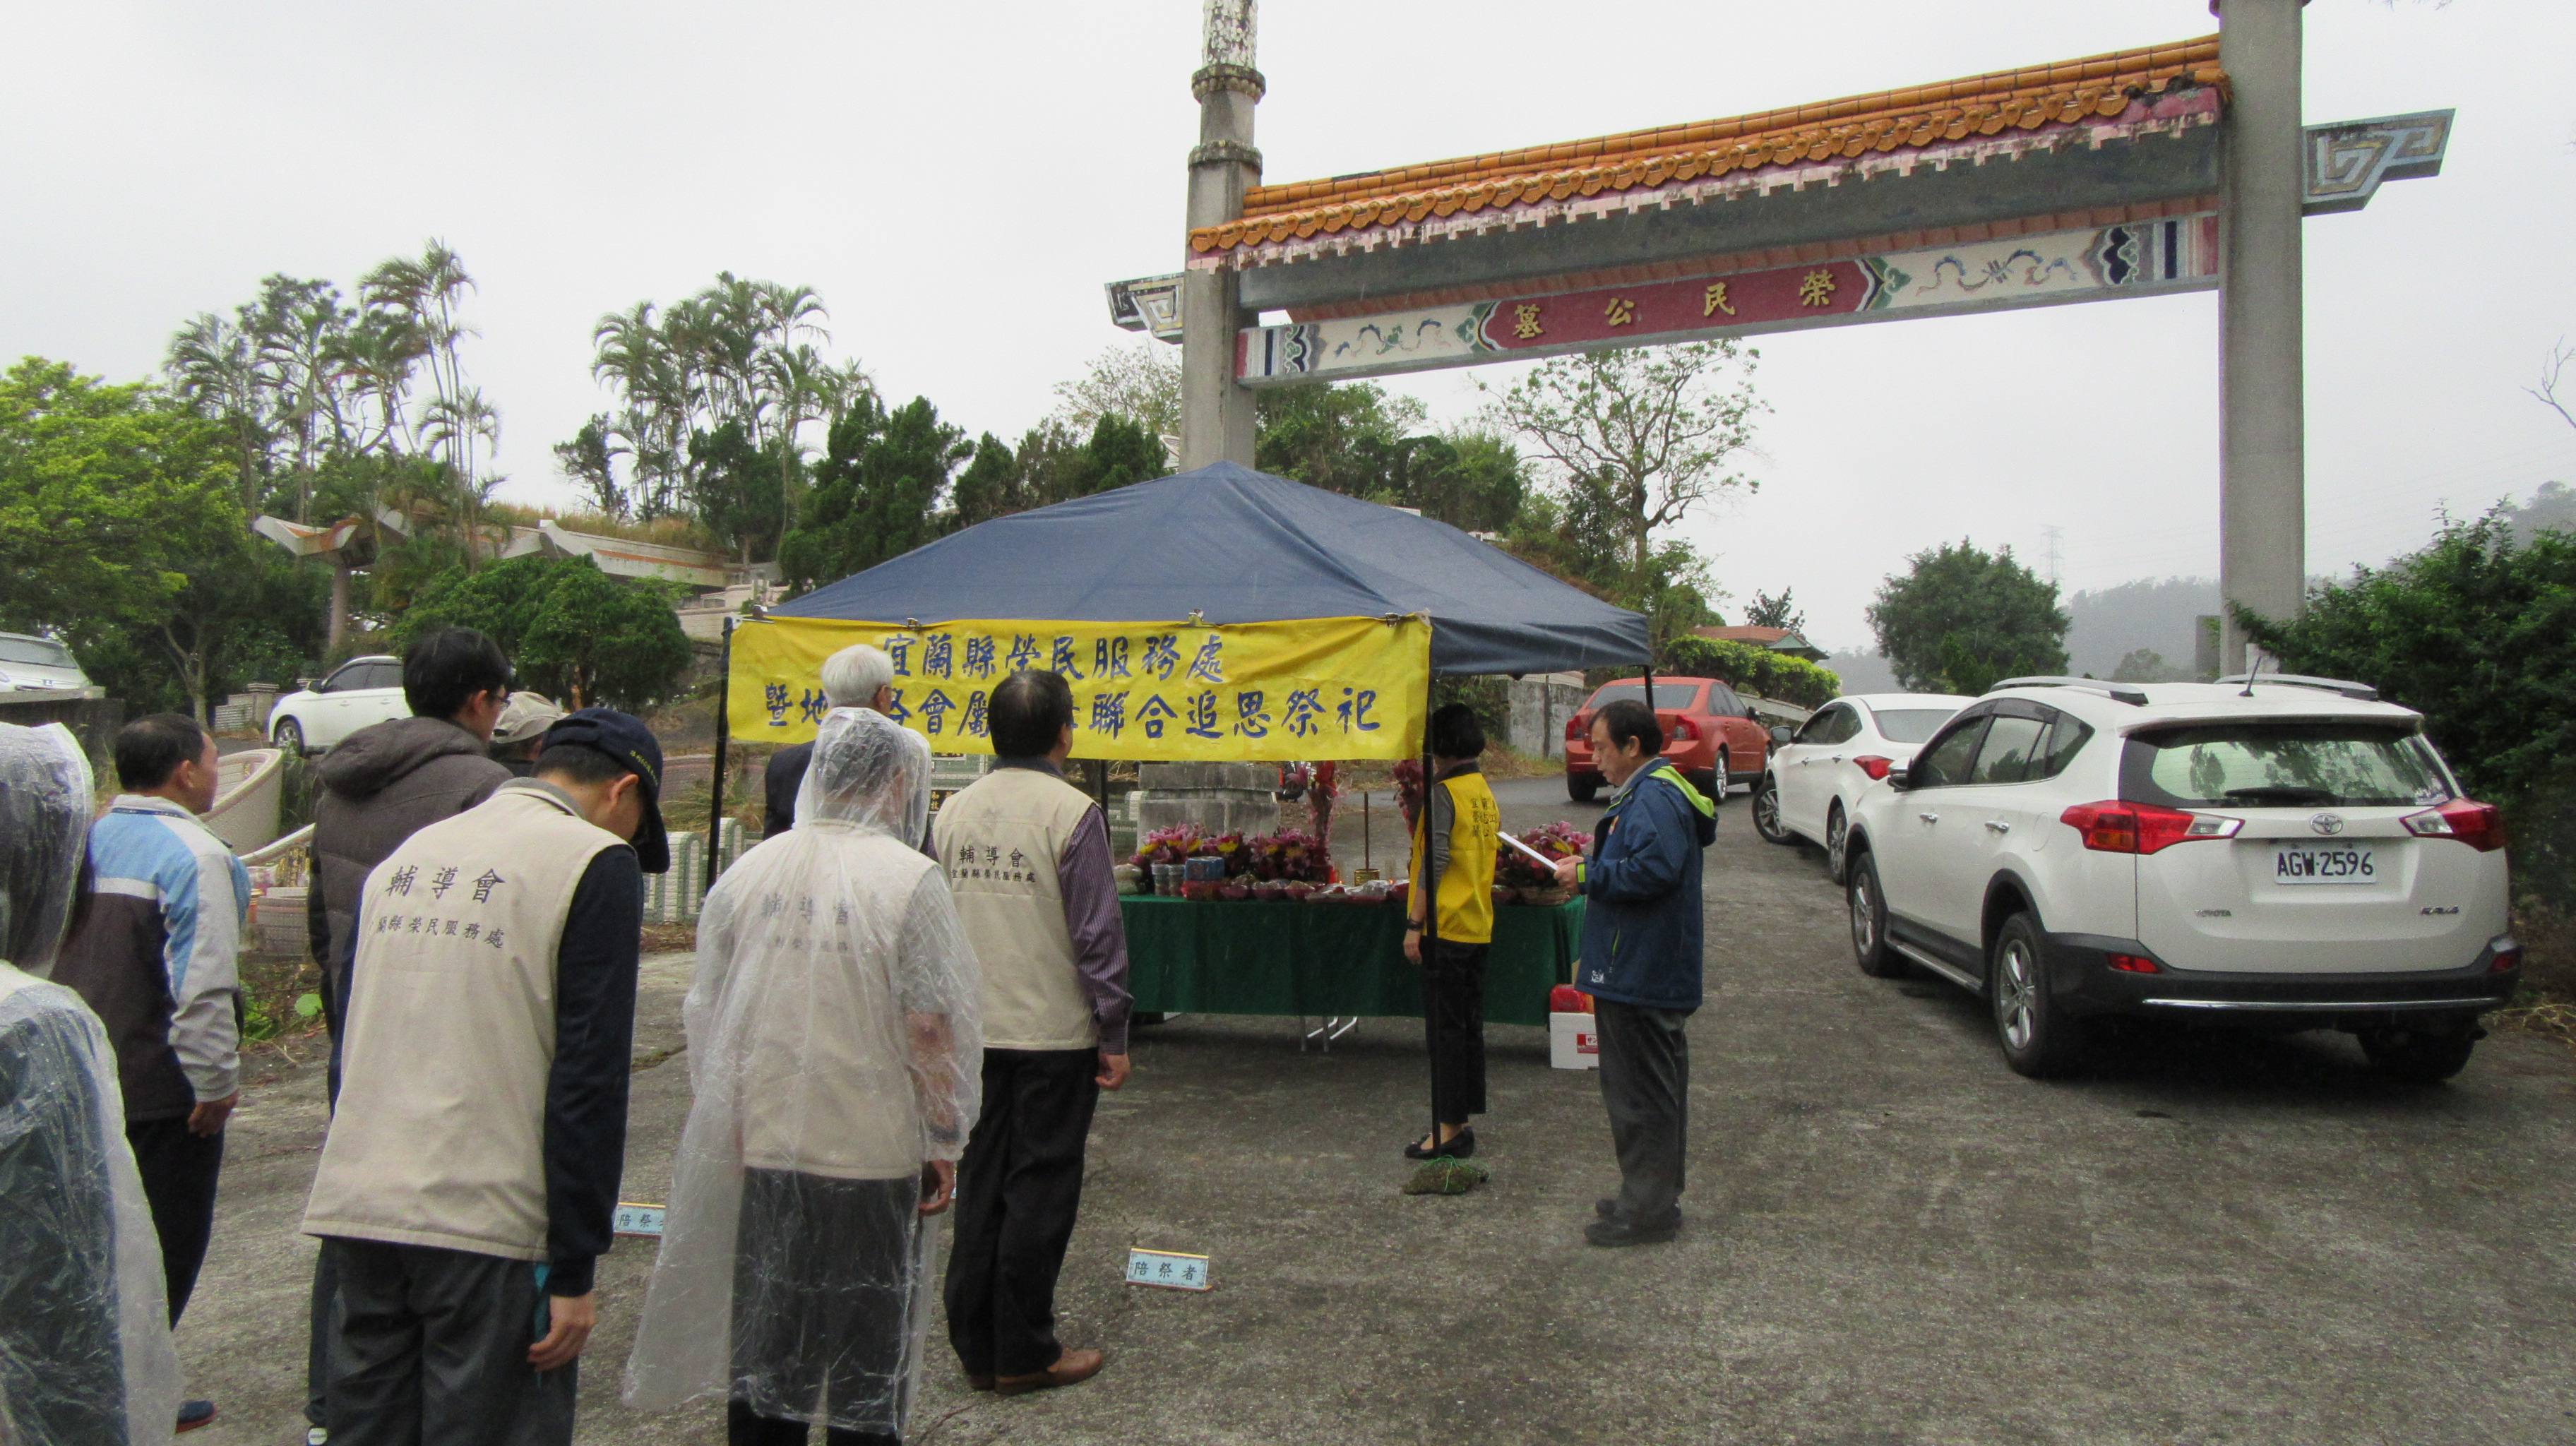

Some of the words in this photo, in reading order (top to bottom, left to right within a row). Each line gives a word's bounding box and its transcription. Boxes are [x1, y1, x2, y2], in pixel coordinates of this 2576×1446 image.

[884, 633, 1223, 682] 宜蘭縣榮民服務處
[959, 845, 1024, 868] 輔導會
[385, 865, 506, 904] 輔導會
[370, 915, 505, 948] 蘭縣榮民服務處
[1134, 1261, 1197, 1281] 陪祭者
